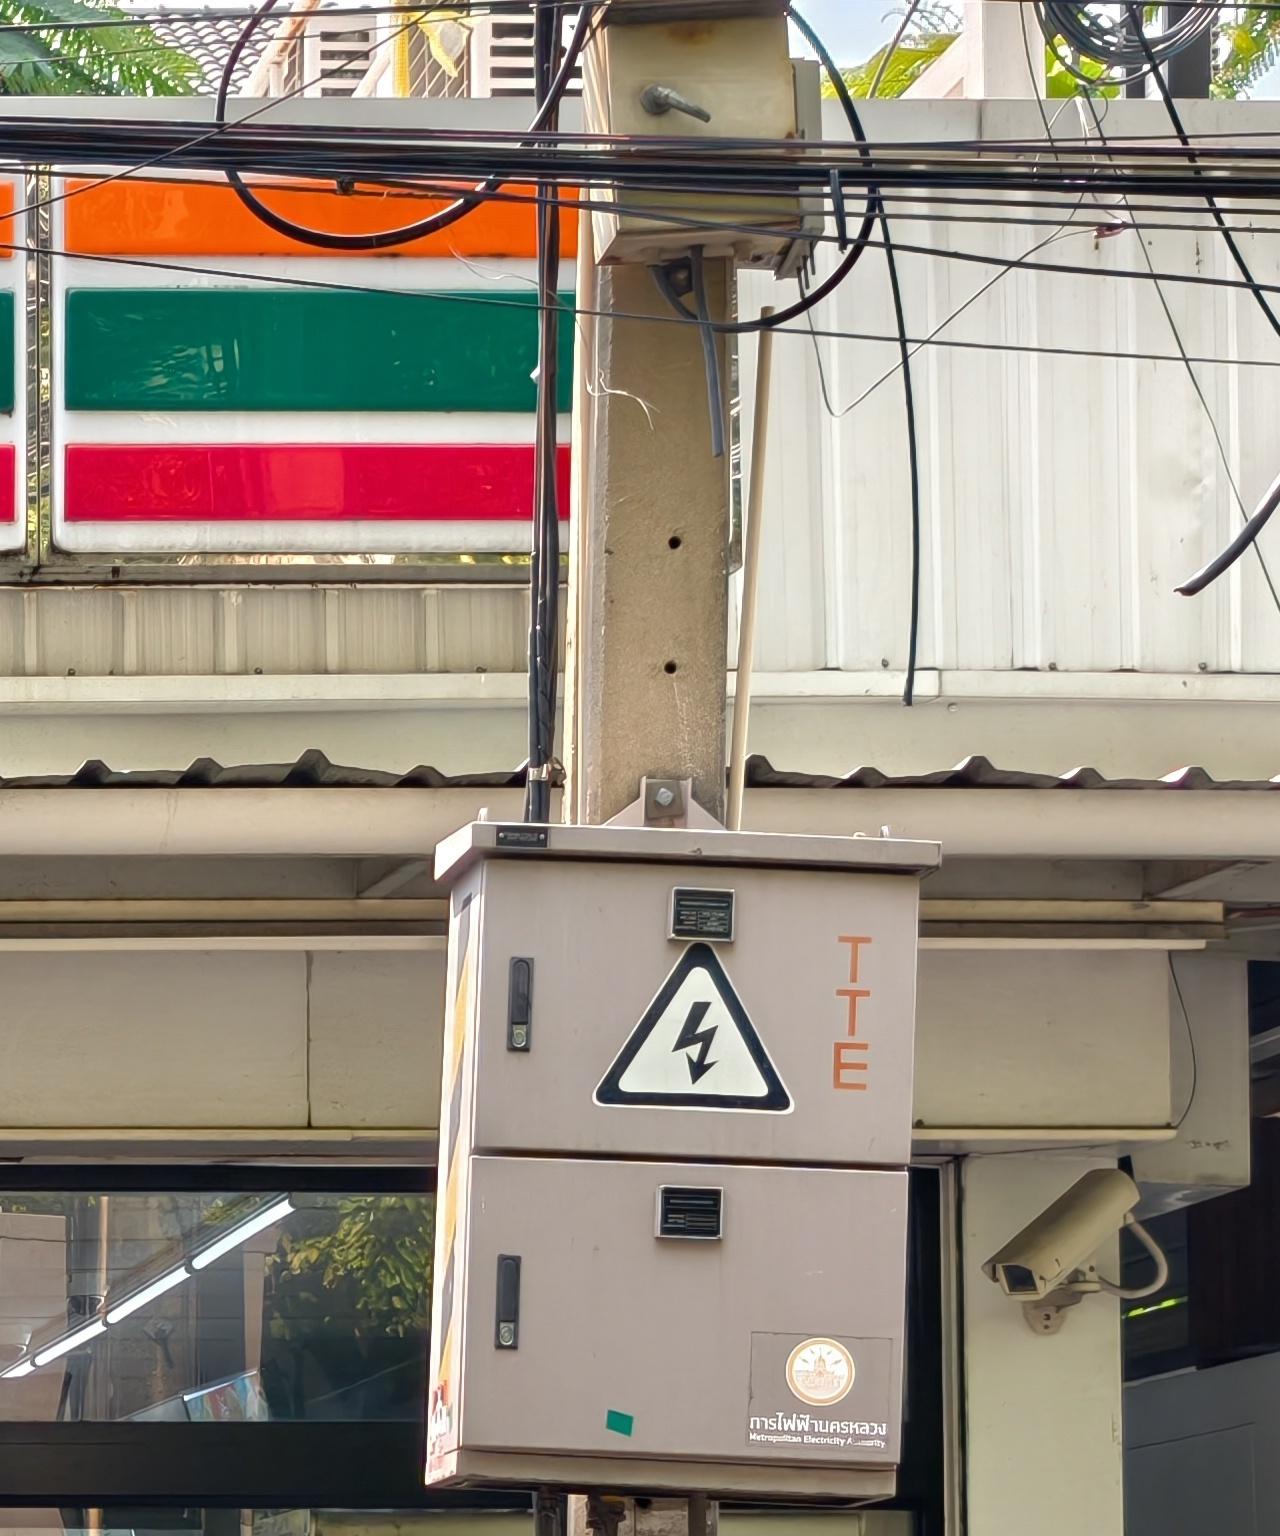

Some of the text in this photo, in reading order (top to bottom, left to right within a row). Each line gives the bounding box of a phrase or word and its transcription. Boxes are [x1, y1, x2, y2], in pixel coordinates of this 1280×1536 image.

[832, 935, 873, 1091] TTE
[749, 1411, 887, 1436] การไฟฟ้านครหลวง
[749, 1431, 846, 1446] Metropolitan Electricity
